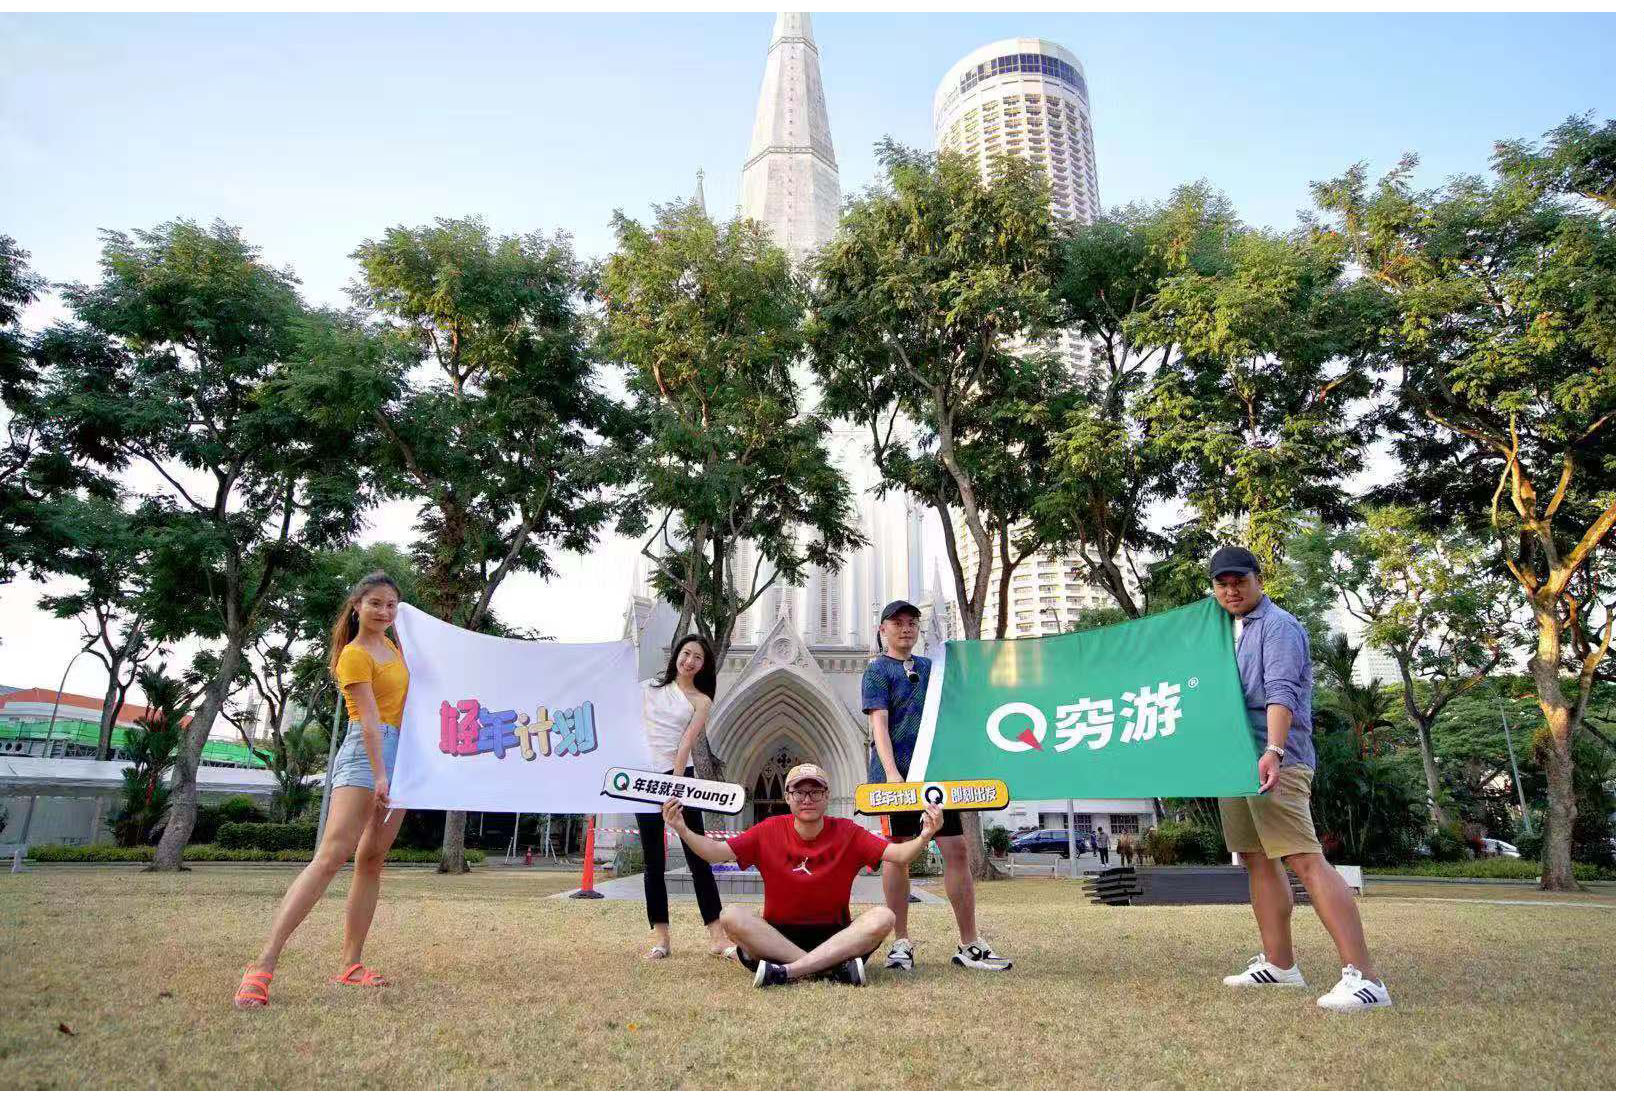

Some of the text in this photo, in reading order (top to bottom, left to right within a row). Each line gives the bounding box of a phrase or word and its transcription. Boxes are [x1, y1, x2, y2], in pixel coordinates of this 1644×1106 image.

[1054, 682, 1183, 753] 穷游
[633, 777, 737, 806] 年轻就是Young!
[951, 785, 997, 803] 即刻出发
